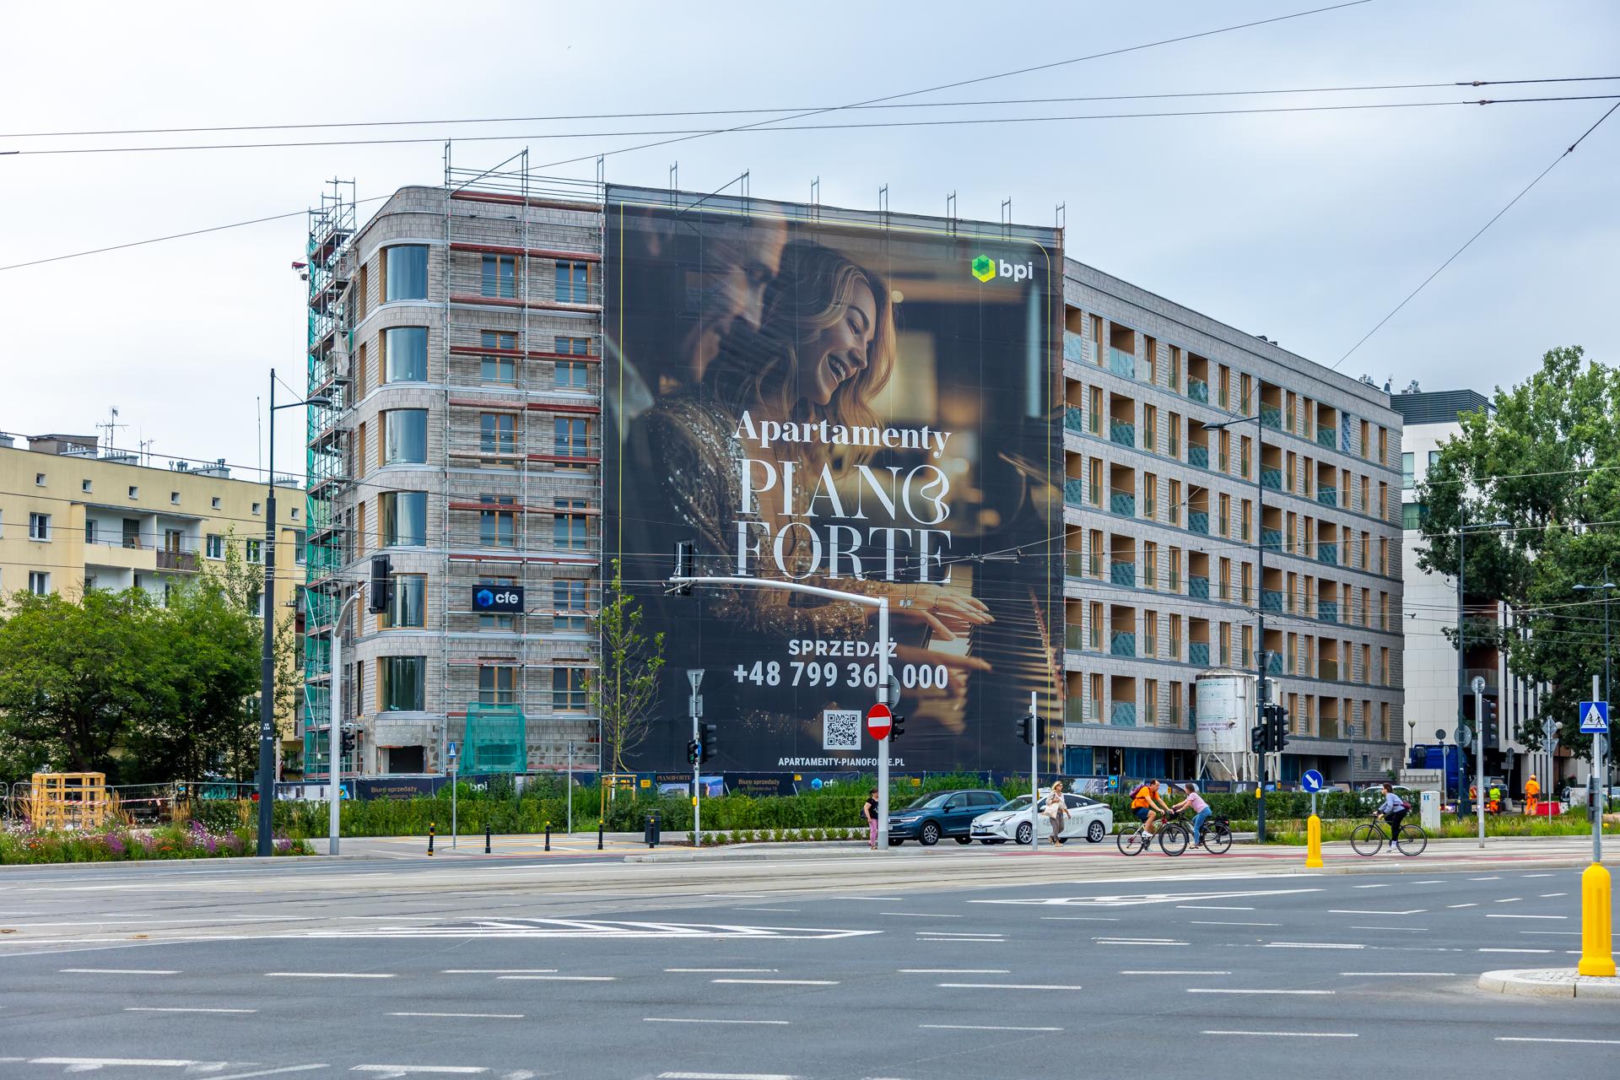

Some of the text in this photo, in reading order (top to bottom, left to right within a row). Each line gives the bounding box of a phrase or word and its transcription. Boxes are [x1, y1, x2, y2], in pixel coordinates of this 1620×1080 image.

[999, 259, 1033, 282] bpi
[733, 410, 952, 459] Apartamenty
[735, 457, 951, 525] PIANO
[731, 520, 952, 584] FORTE
[495, 591, 519, 604] cfe
[733, 661, 949, 689] +48 799 36 000
[778, 757, 905, 767] APARTAMENTY-PIANOFOE.PL
